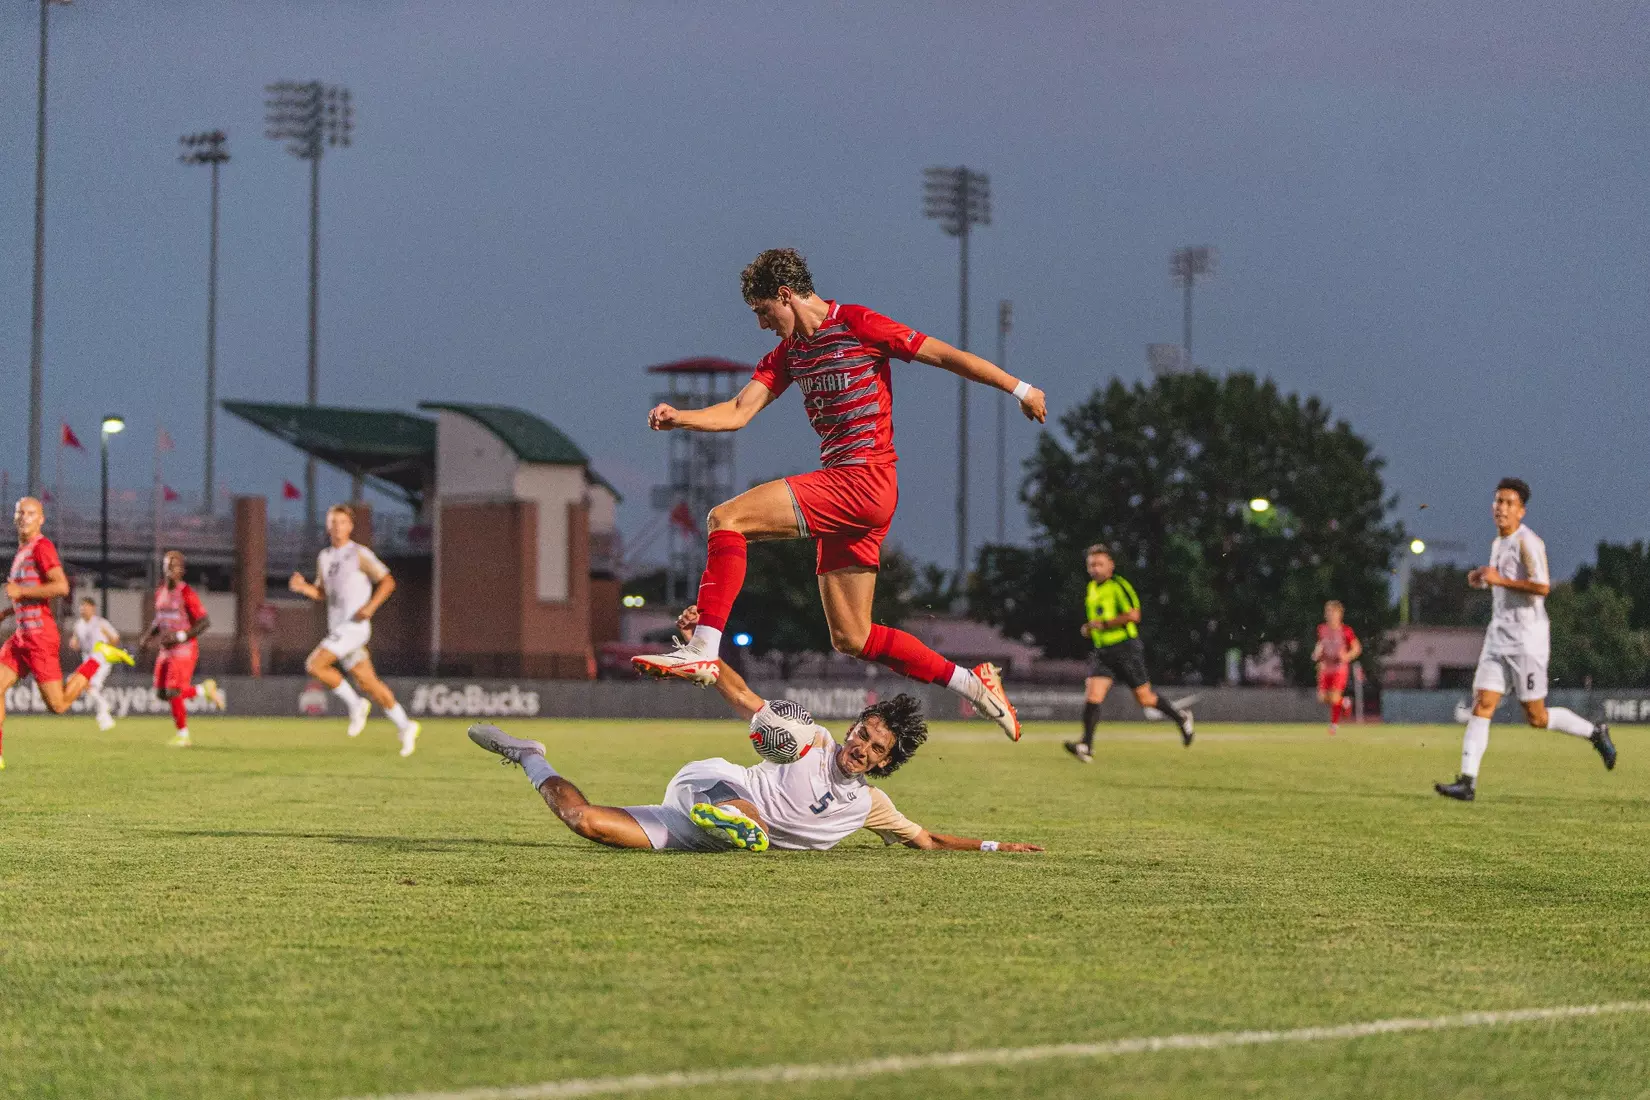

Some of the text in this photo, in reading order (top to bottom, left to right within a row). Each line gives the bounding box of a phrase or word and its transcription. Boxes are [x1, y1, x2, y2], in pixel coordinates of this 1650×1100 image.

[815, 372, 851, 391] STATE
[1527, 672, 1536, 690] 6
[411, 684, 540, 715] #GoBucks
[809, 791, 834, 815] 5
